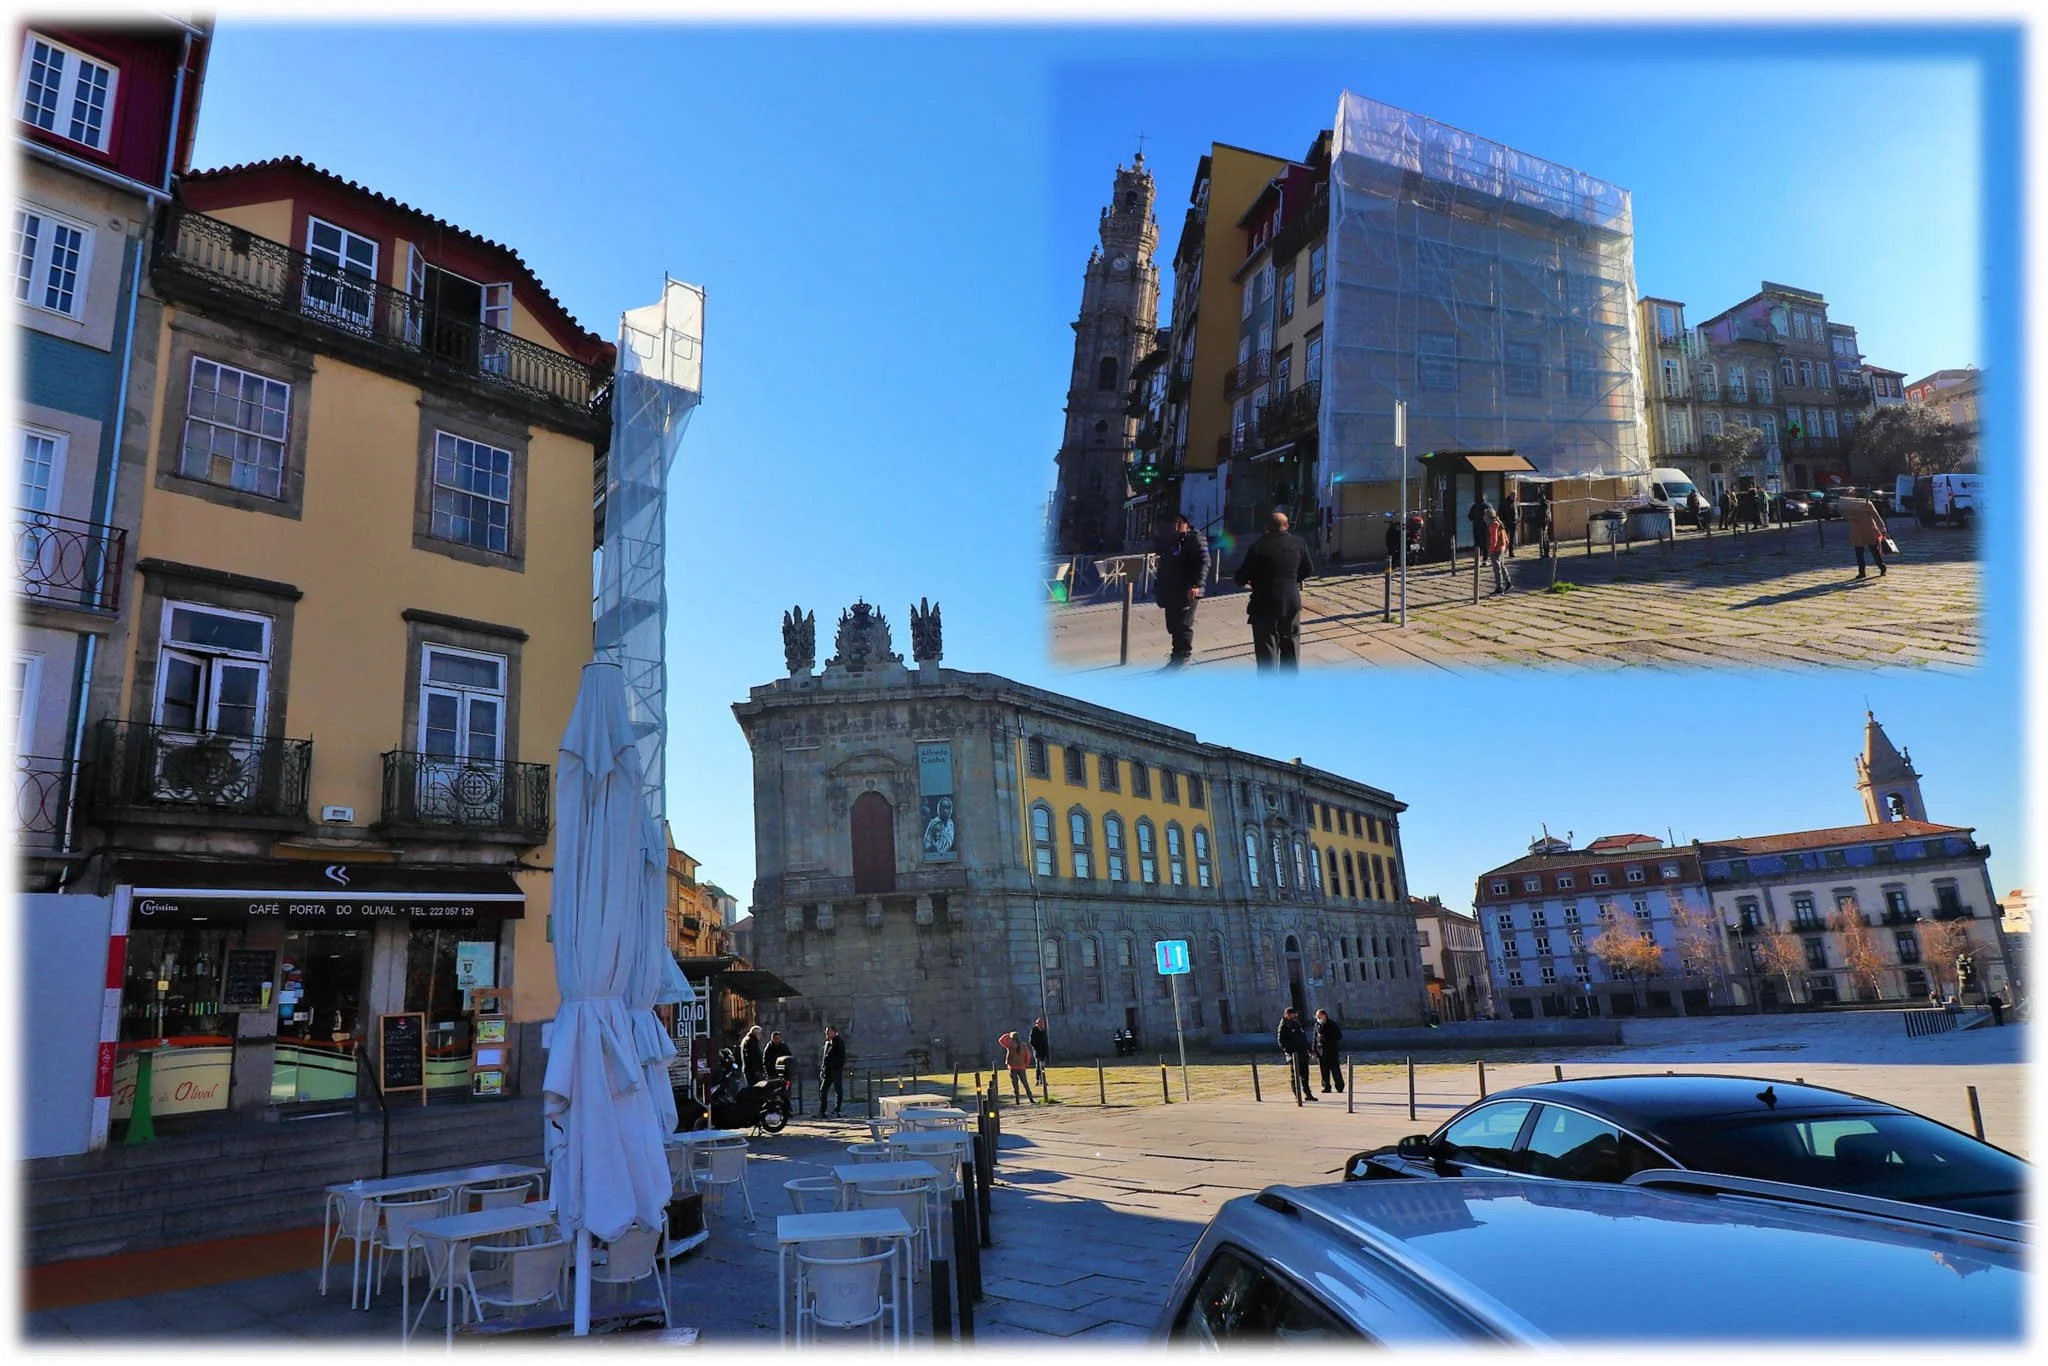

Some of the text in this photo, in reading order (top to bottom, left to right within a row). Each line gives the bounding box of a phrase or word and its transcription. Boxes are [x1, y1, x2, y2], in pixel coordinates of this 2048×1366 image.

[921, 748, 949, 756] Alfredo
[921, 756, 945, 764] Cunha
[140, 900, 178, 915] Christina
[249, 903, 279, 915] CAFÉ
[289, 904, 326, 915] PORTA
[336, 905, 352, 915] DO
[361, 905, 397, 915] OLIVAL
[429, 907, 444, 916] 222
[445, 907, 459, 916] 057
[461, 907, 474, 916] 129
[175, 1080, 219, 1101] Olival
